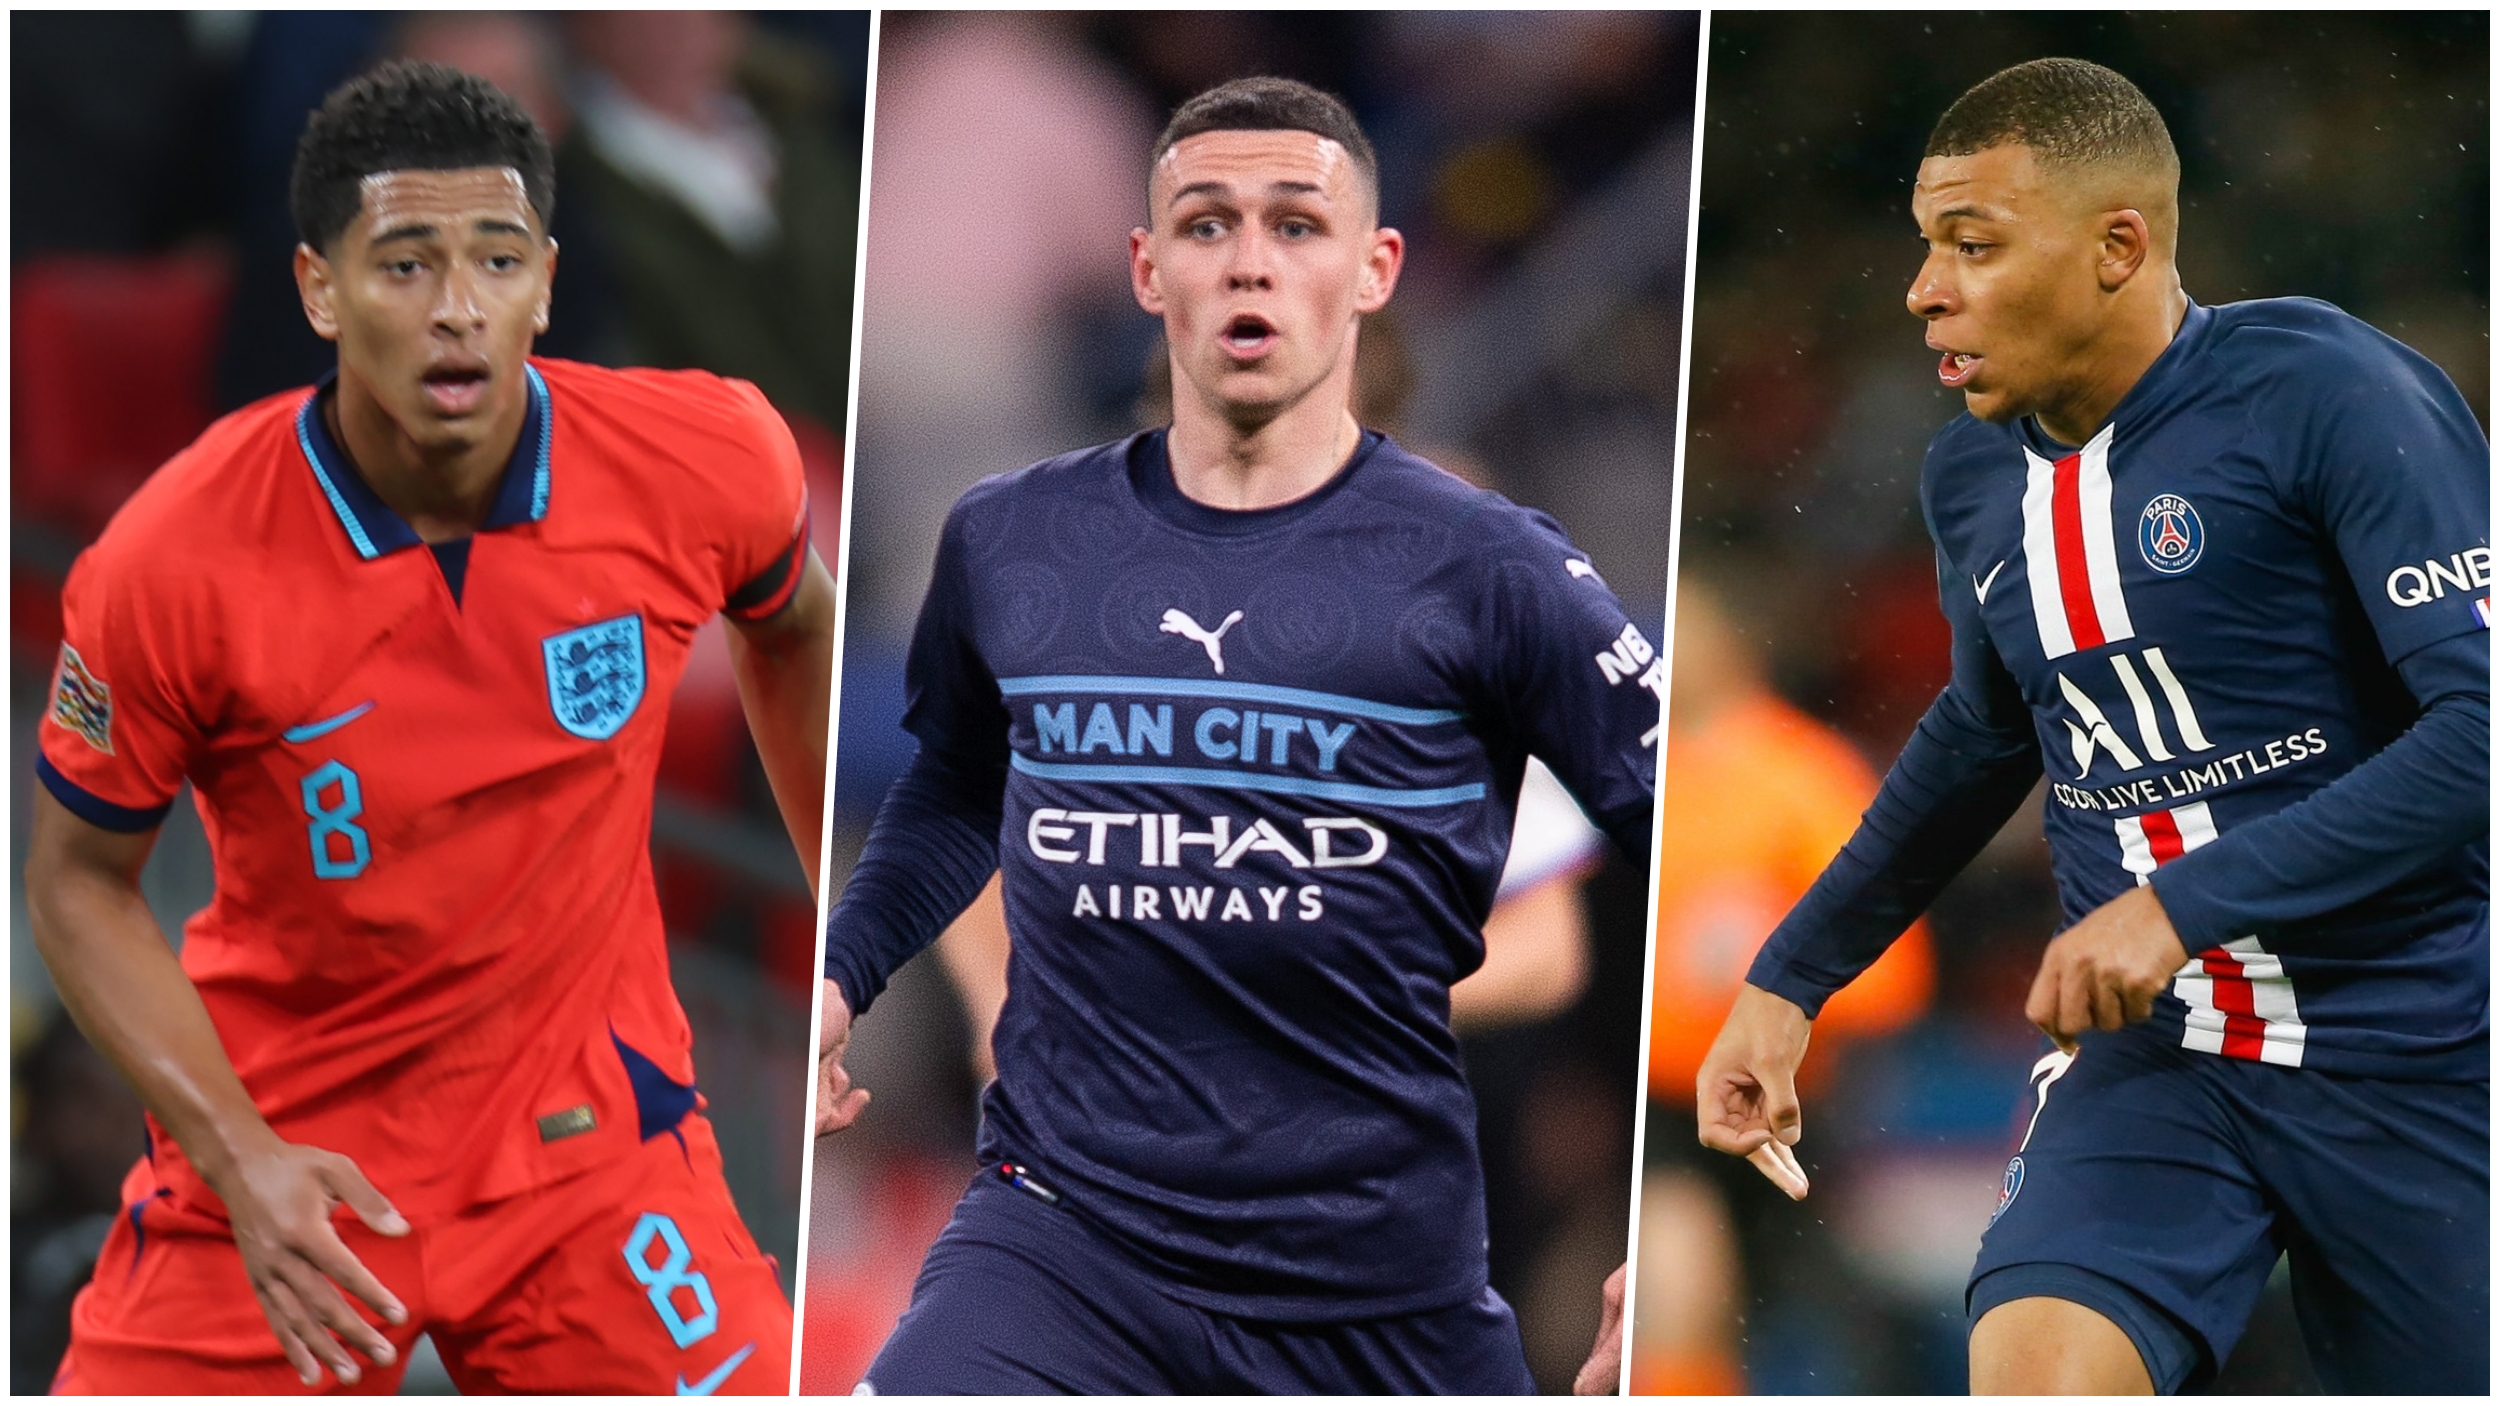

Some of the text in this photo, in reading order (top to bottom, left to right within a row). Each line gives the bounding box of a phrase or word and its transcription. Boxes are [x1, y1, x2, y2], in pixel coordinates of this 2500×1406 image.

[2146, 498, 2187, 520] PARIS
[2386, 546, 2490, 608] QNB
[1033, 703, 1356, 772] MAN CITY
[2096, 779, 2163, 811] LIVE
[2162, 728, 2327, 798] LIMITLESS
[301, 759, 371, 880] 8
[1027, 807, 1389, 869] ETIHAD
[1072, 884, 1324, 922] AIRWAYS
[623, 1212, 719, 1350] 8
